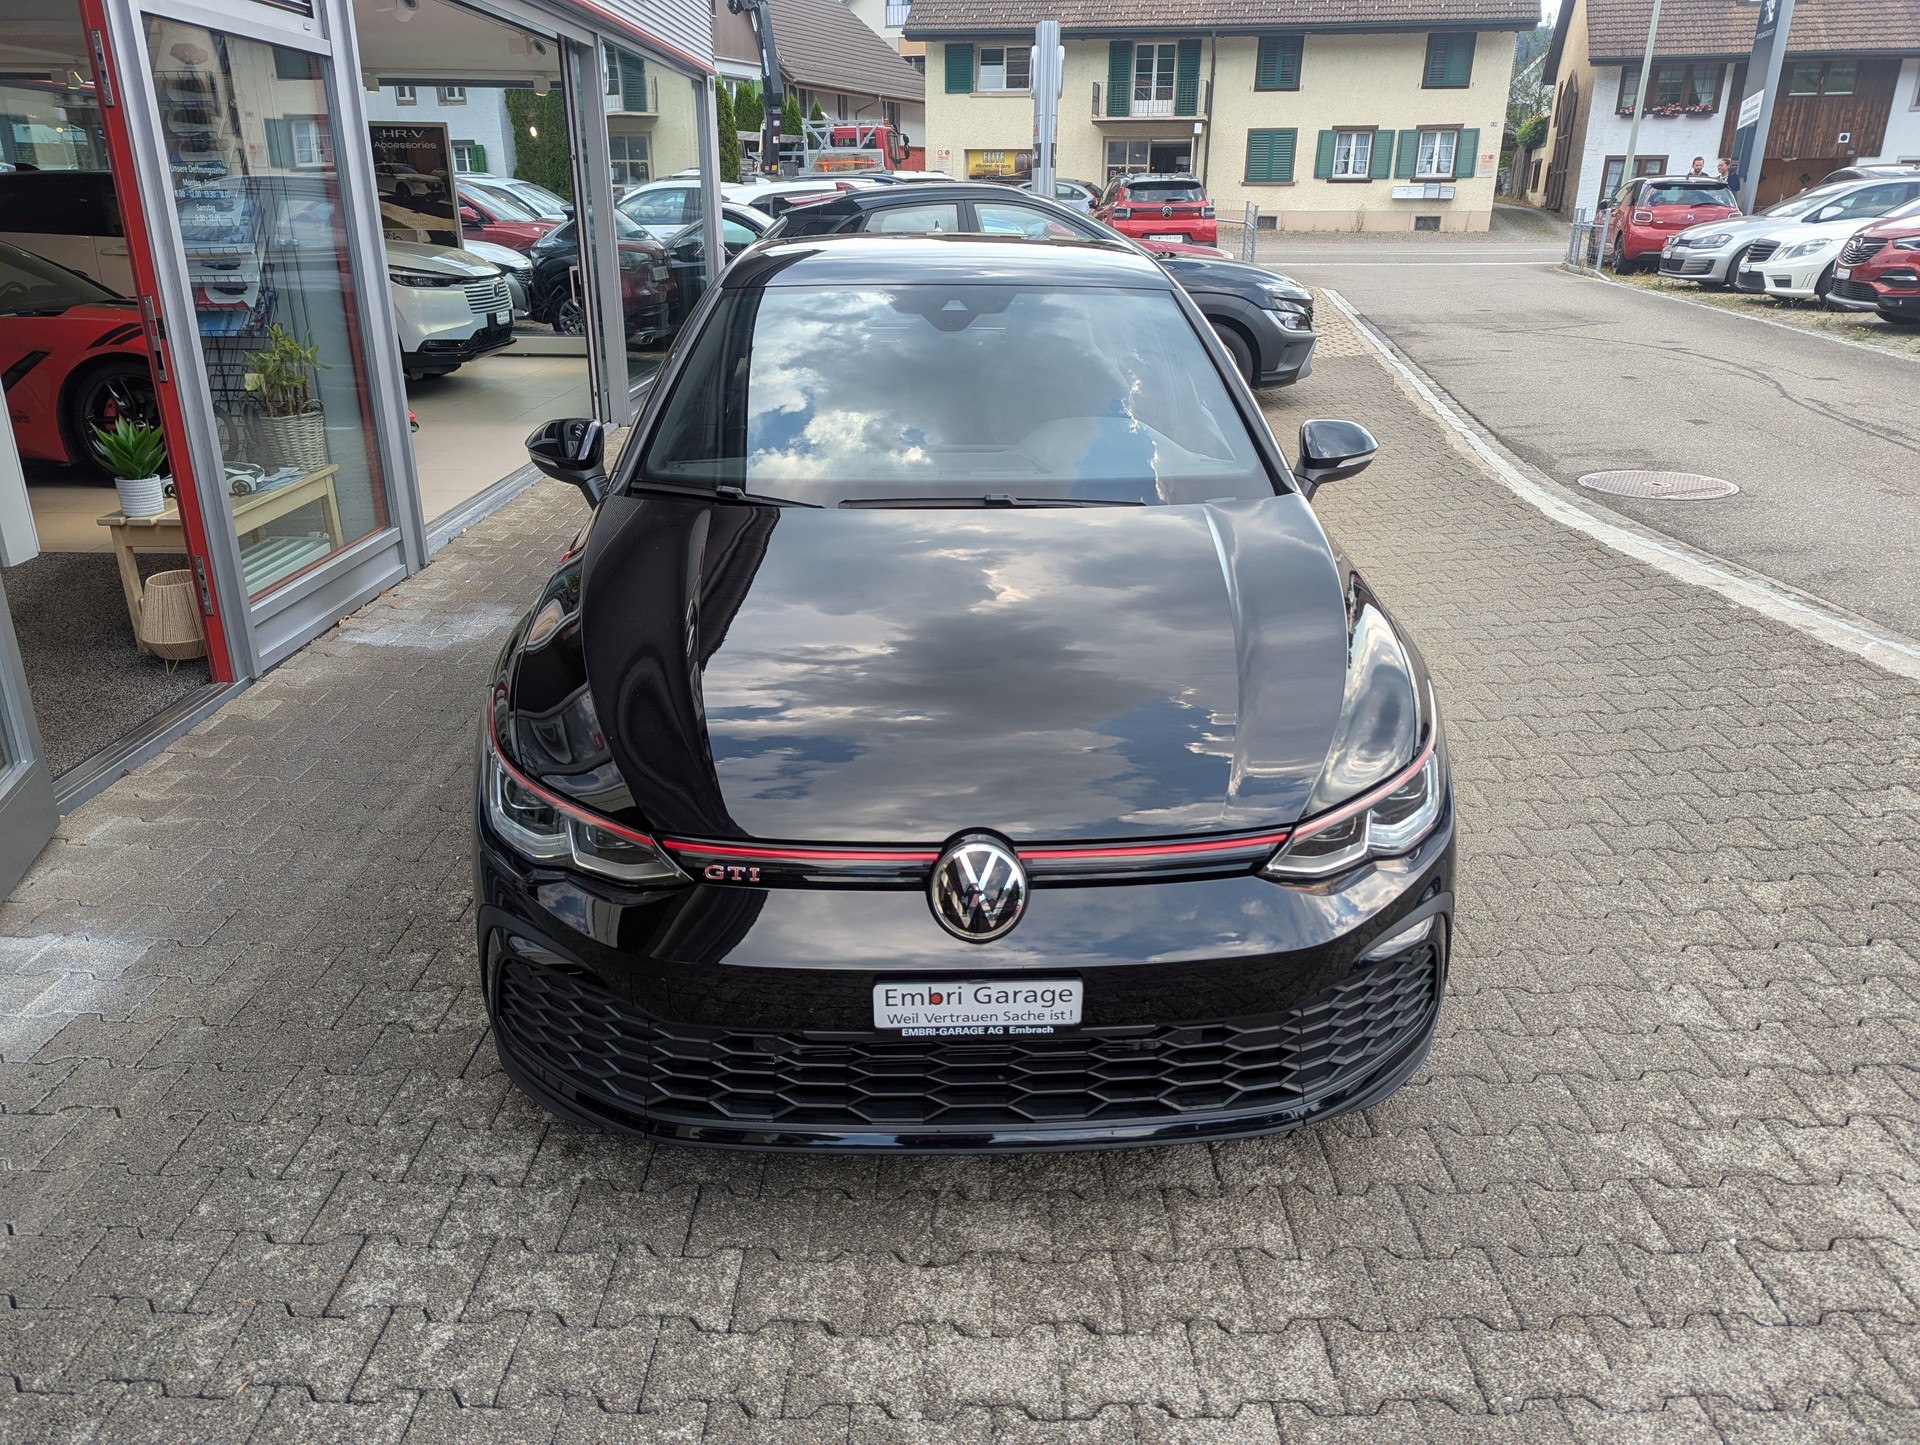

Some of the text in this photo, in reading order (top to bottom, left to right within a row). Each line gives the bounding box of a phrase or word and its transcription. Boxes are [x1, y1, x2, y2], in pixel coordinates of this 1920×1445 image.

[382, 129, 424, 138] HR-V
[374, 141, 437, 149] Accessories
[170, 164, 188, 173] Unsere
[196, 203, 216, 213] Samstag
[704, 864, 760, 882] GTI
[884, 986, 1073, 1008] Embri Garage
[887, 1013, 919, 1024] Weil
[924, 1012, 999, 1024] Vertrauen
[1003, 1010, 1046, 1022] Sache
[901, 1026, 1054, 1037] EMBRI-GARAGE AG Embrach
